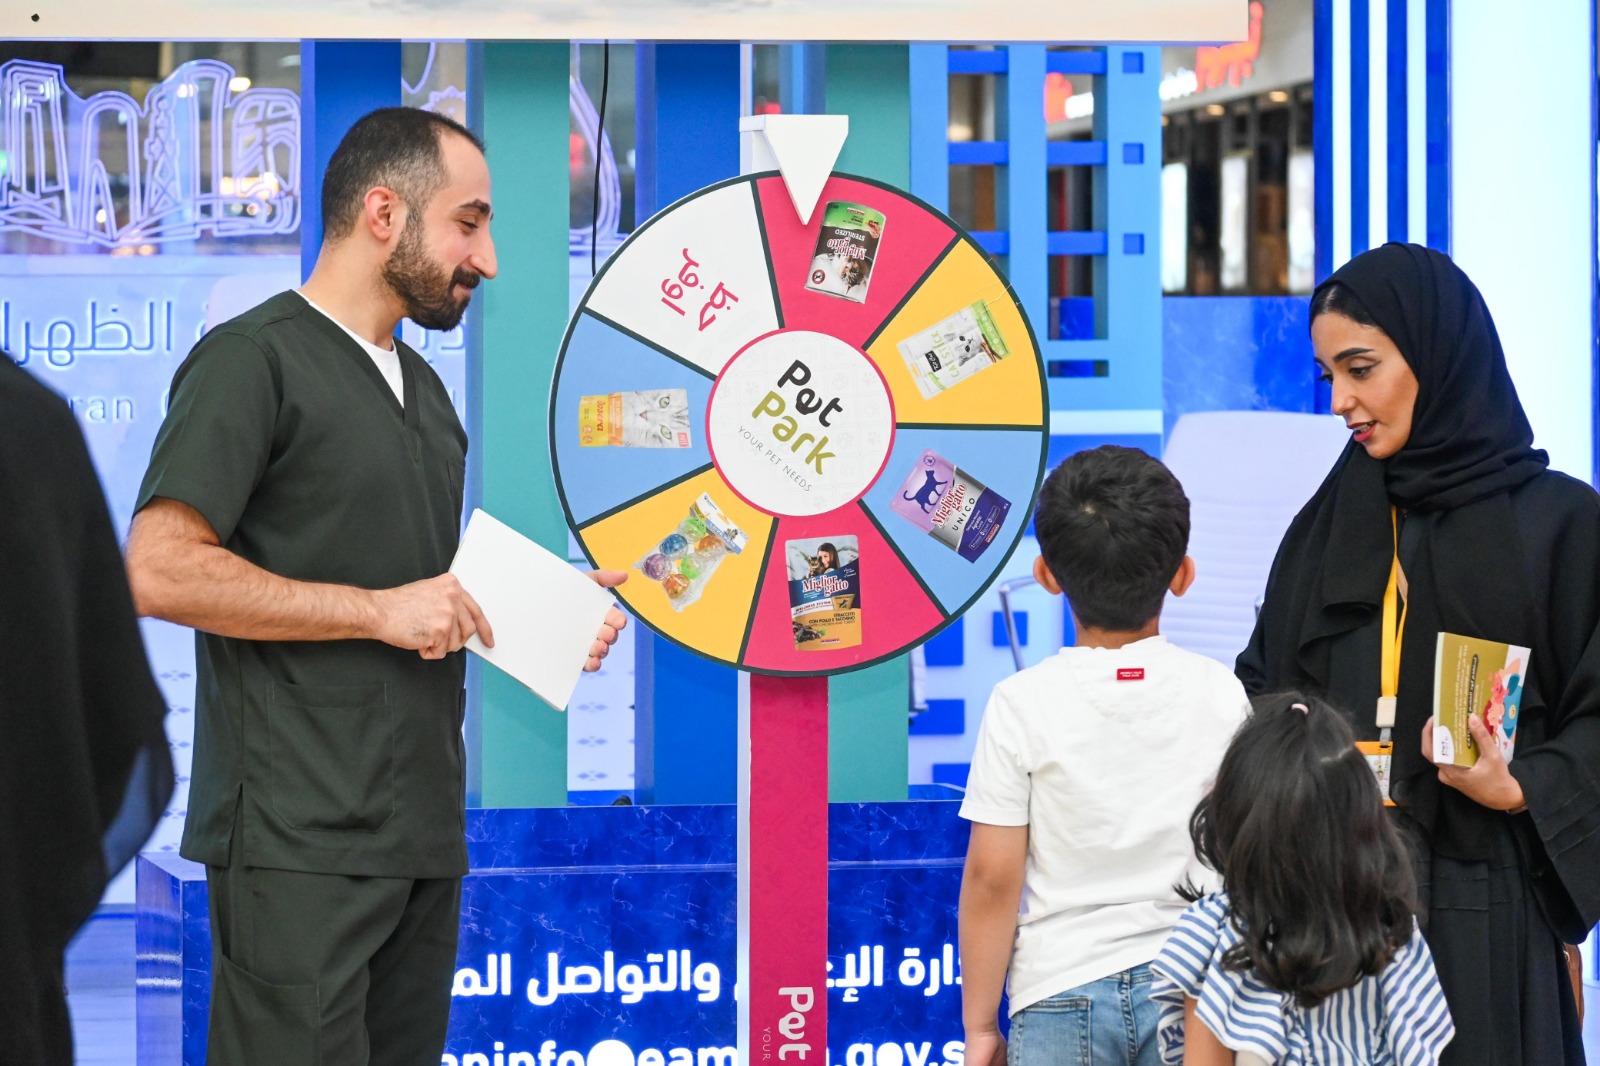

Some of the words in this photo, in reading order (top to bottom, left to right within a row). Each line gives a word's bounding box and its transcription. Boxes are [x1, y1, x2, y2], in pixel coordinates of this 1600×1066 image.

[834, 228, 866, 241] STERILIZED
[660, 247, 705, 317] اوفر
[698, 281, 739, 332] حظ
[3, 300, 172, 367] الظهرا
[777, 359, 844, 428] Pet
[751, 390, 837, 475] Park
[738, 425, 764, 452] YOUR
[764, 448, 783, 465] PET
[782, 464, 814, 492] NEEDS
[931, 489, 956, 528] Miglior
[951, 483, 967, 513] gatto
[951, 497, 976, 531] UNICO
[802, 575, 838, 593] Miglior
[824, 579, 850, 597] gatto
[451, 952, 512, 997] الم
[526, 949, 721, 1006] والتواصل
[897, 943, 963, 997] ارة
[762, 1027, 771, 1061] YOUR
[778, 986, 815, 1061] Pet
